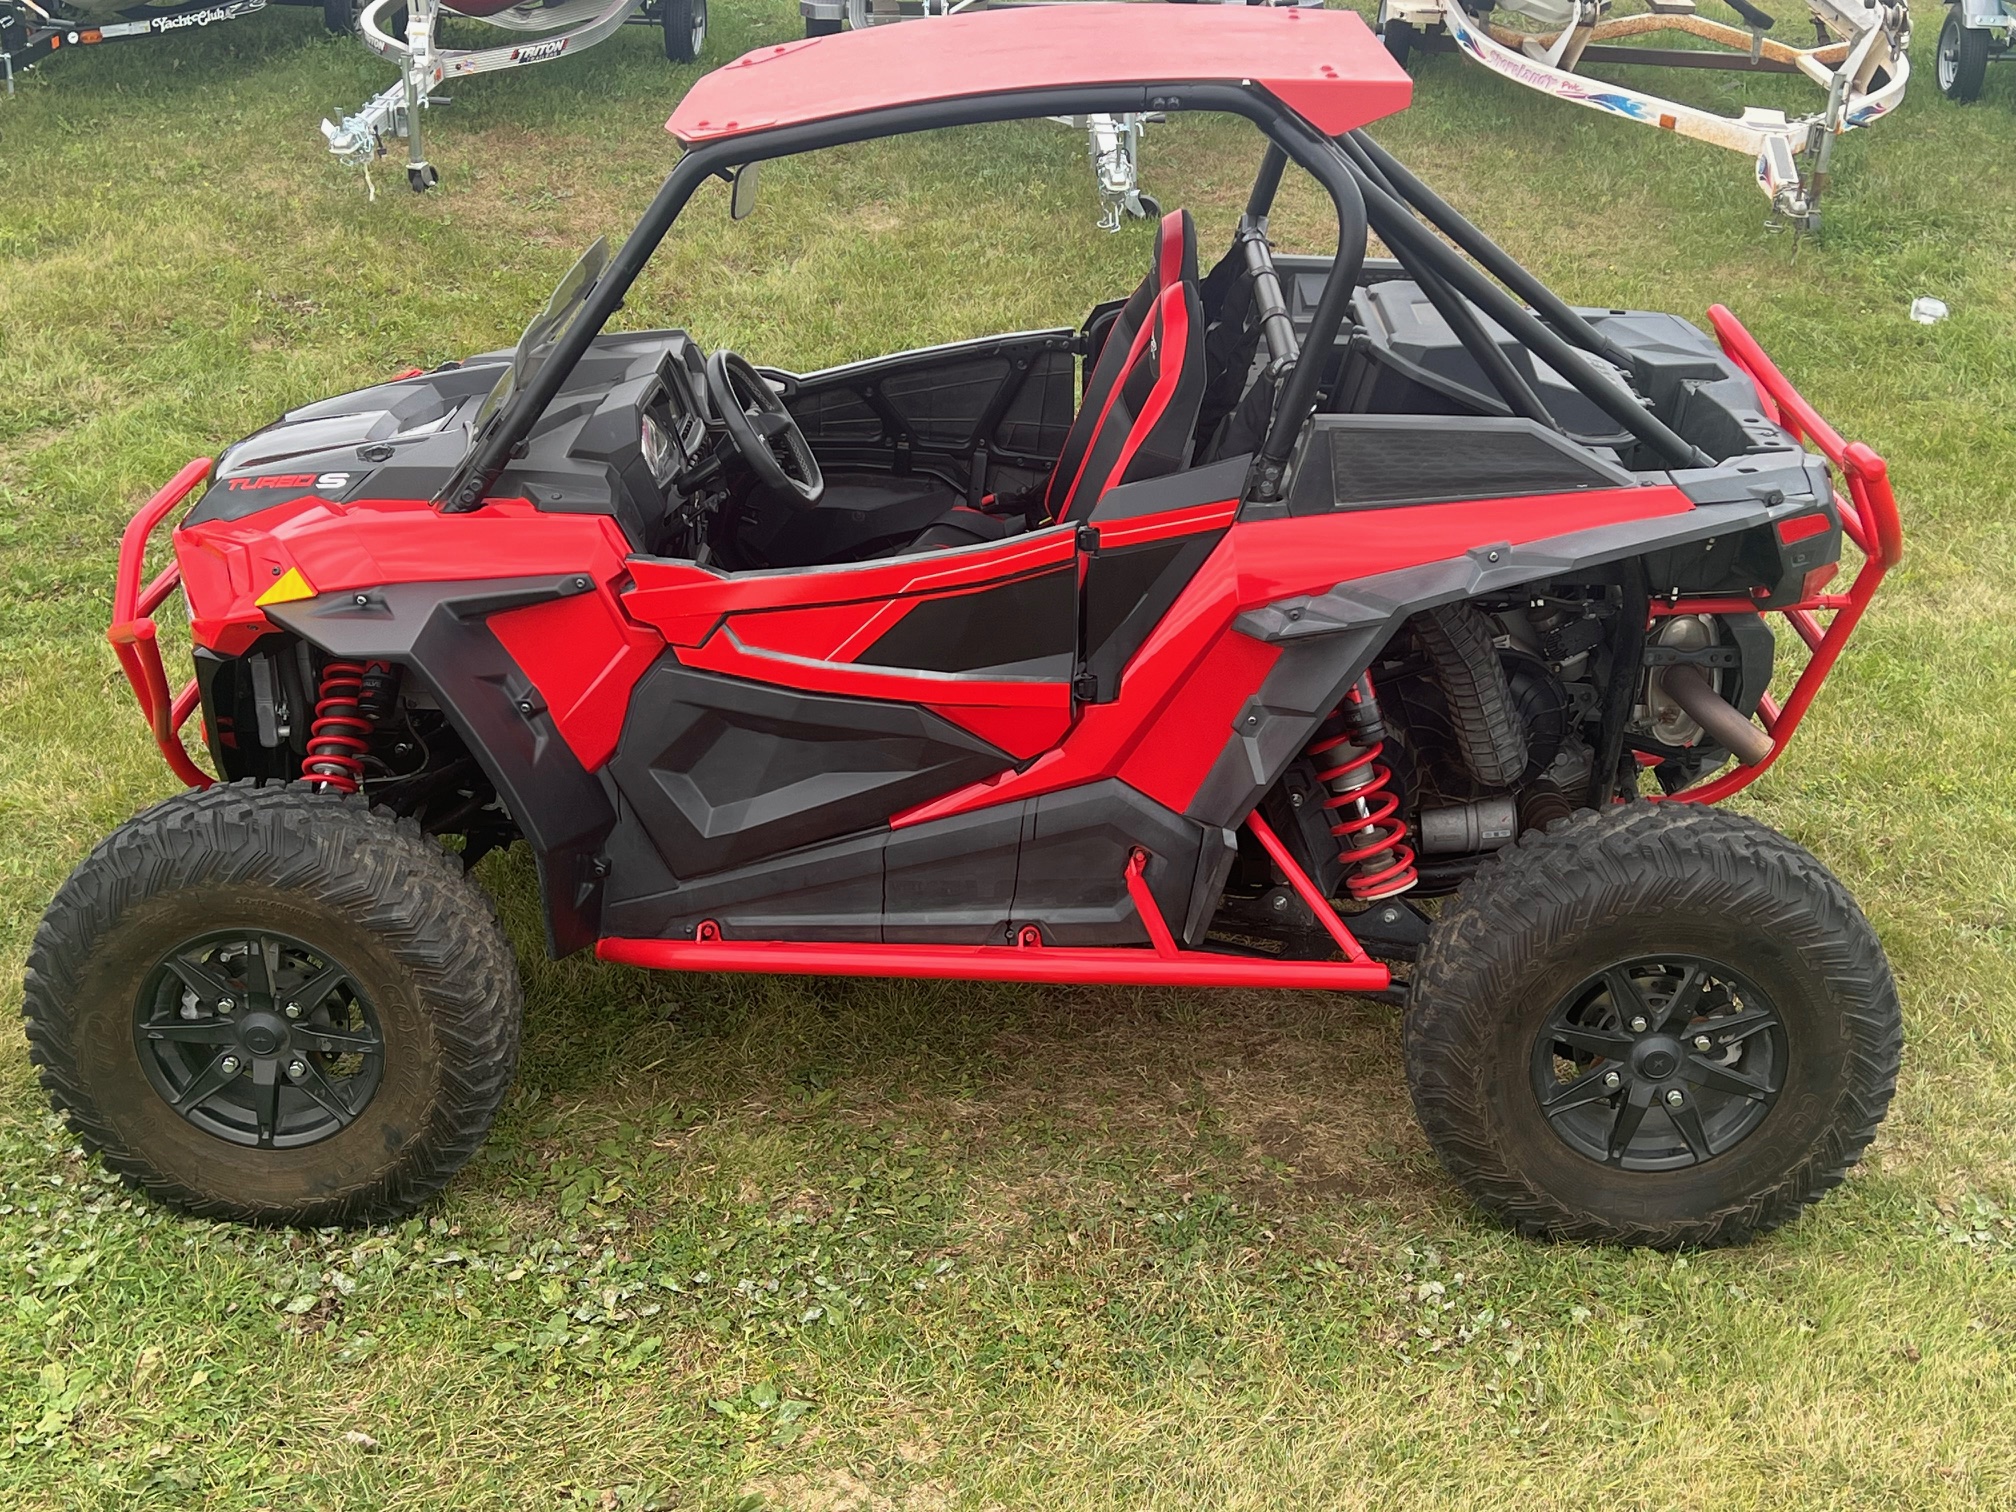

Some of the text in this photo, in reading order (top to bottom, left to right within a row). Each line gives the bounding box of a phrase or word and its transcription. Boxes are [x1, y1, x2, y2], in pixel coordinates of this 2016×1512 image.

[517, 39, 565, 60] TRITON
[228, 472, 350, 491] TURBO S
